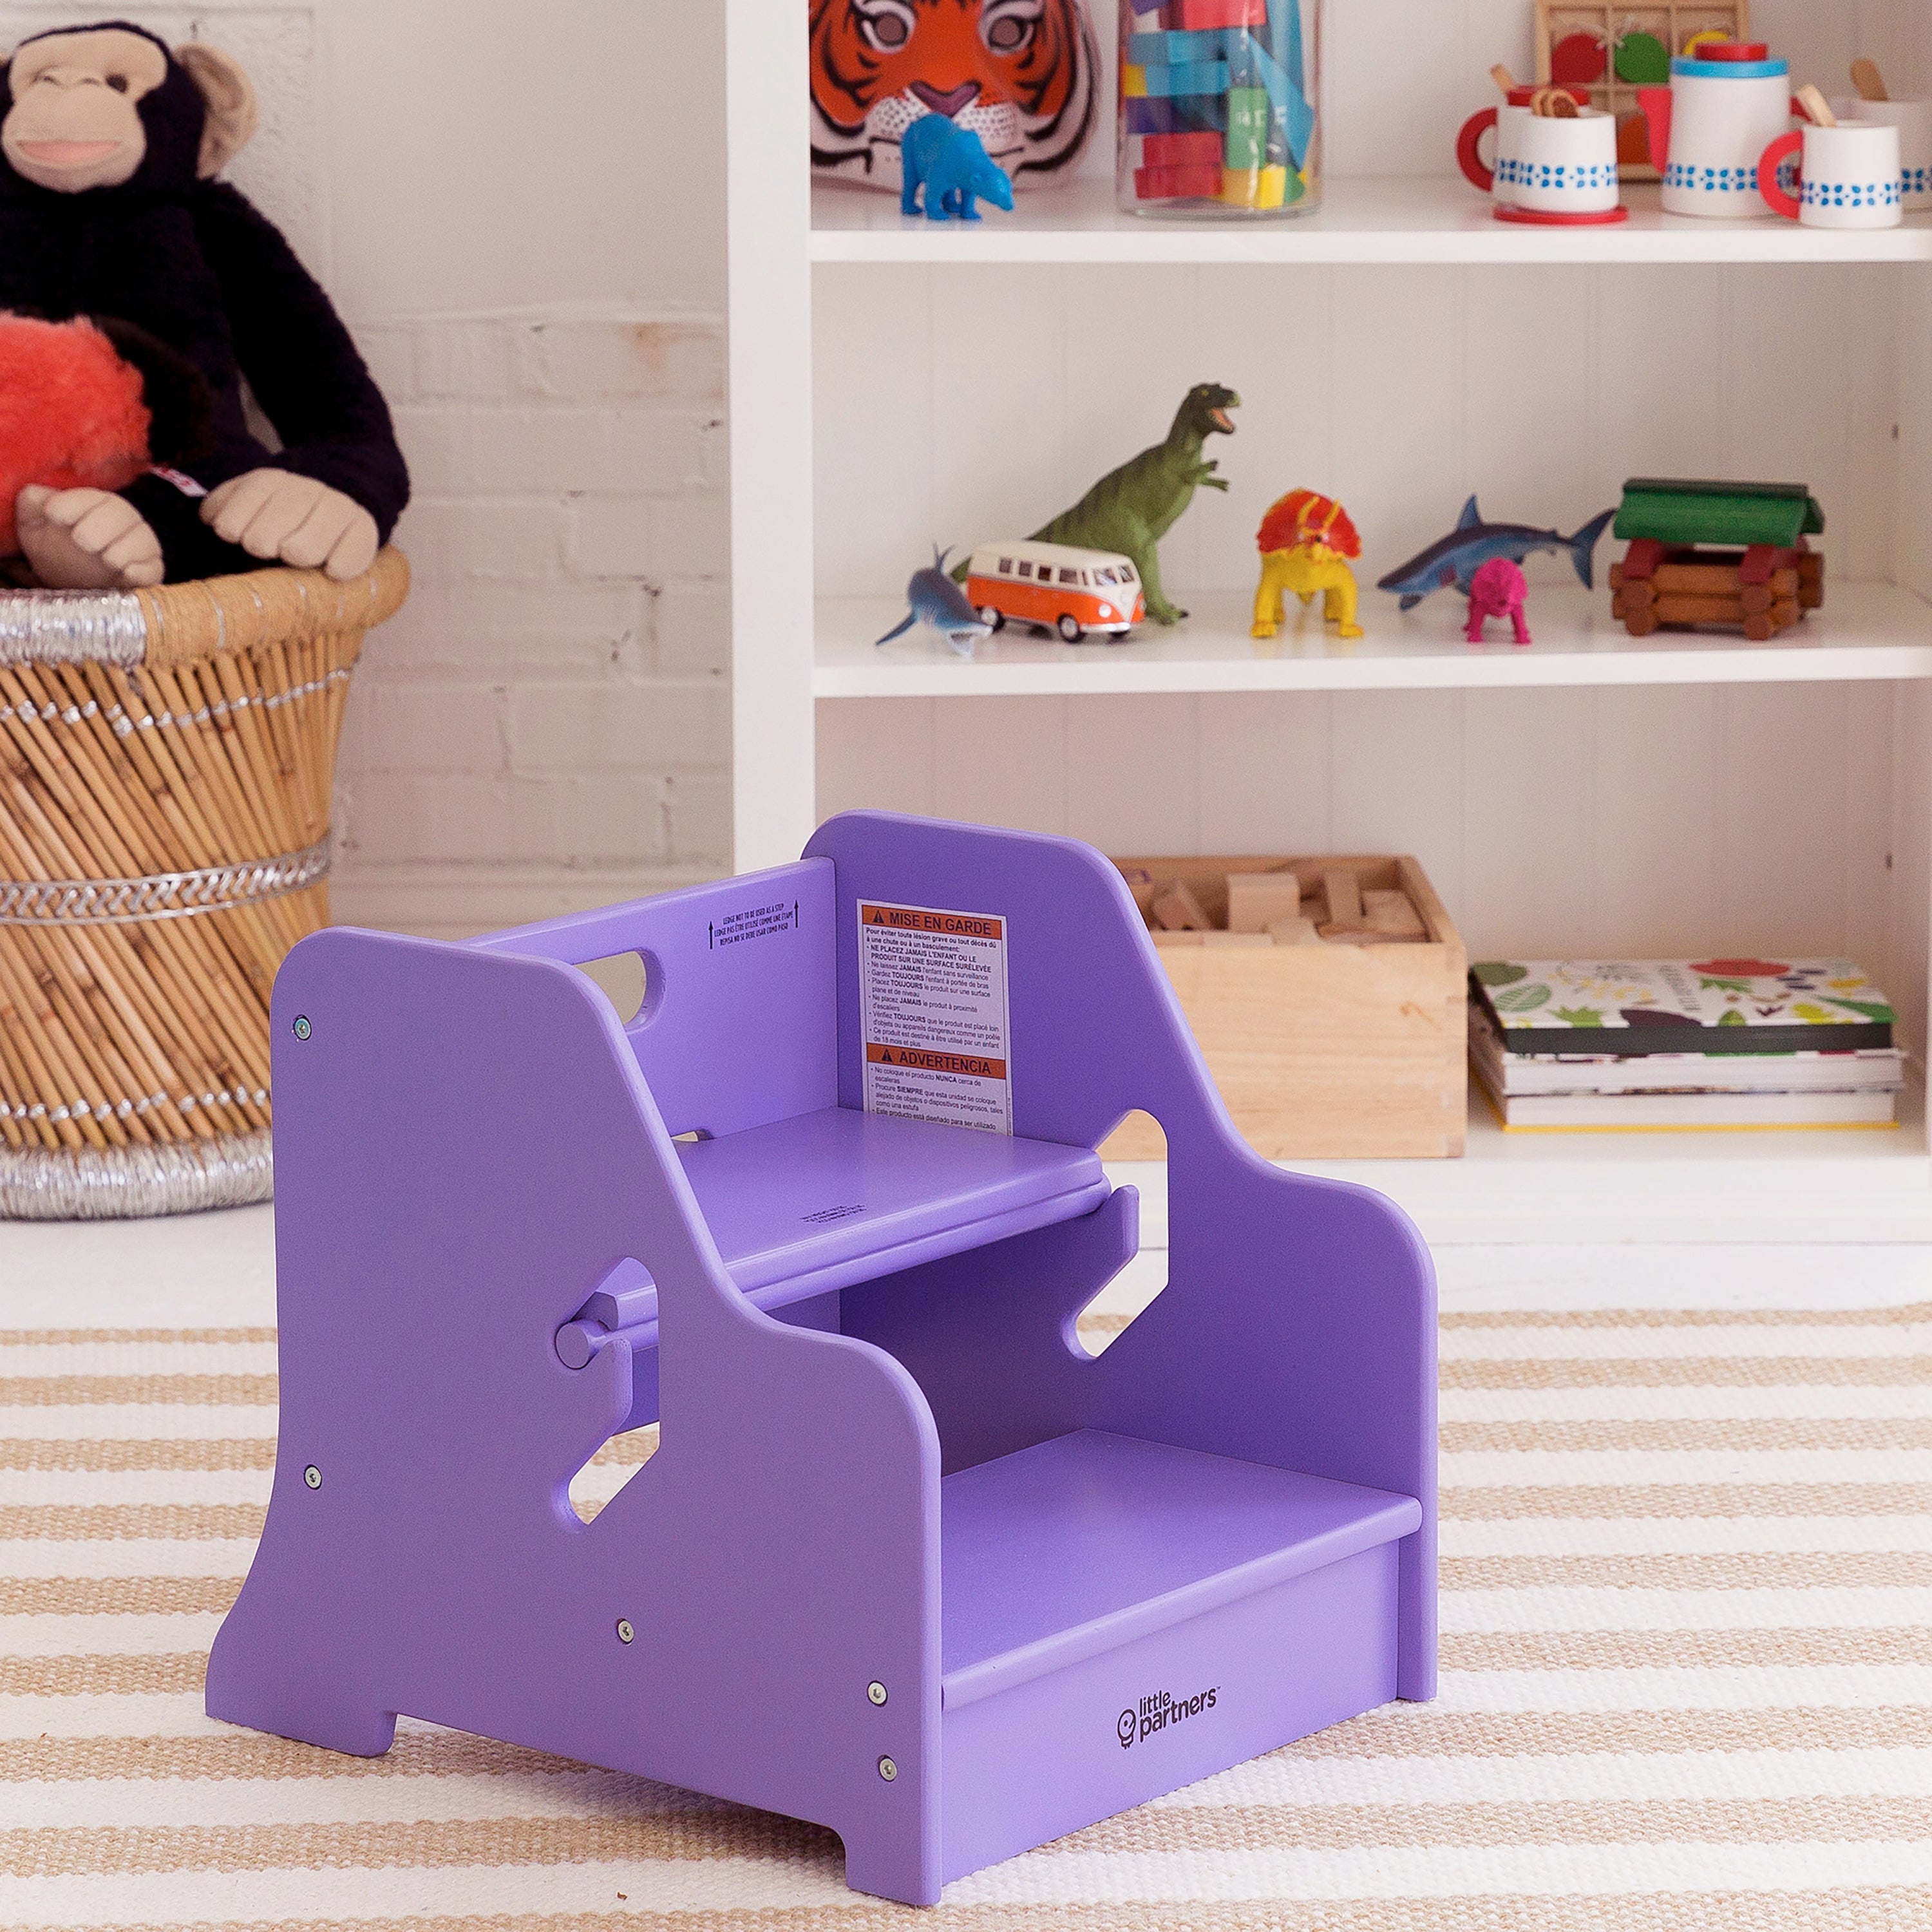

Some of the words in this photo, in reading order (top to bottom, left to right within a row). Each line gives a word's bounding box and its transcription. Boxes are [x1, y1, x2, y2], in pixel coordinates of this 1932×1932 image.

[723, 916, 735, 925] LEDGE
[744, 911, 749, 919] TO
[889, 912, 920, 927] MISE
[924, 916, 941, 929] EN
[945, 918, 991, 934] GARDE
[880, 945, 903, 954] PLACEZ
[905, 948, 927, 956] JAMAIS
[871, 952, 896, 961] PRODUIT
[926, 959, 954, 968] SURFACE
[892, 972, 923, 981] TOUJOURS
[951, 979, 967, 987] portée
[899, 964, 921, 972] JAMAIS
[957, 972, 988, 981] surveillance
[891, 980, 922, 989] TOUJOURS
[930, 985, 948, 994] produit
[881, 996, 898, 1004] placez
[929, 1001, 947, 1010] produit
[953, 1004, 977, 1014] proximité
[894, 1013, 925, 1023] TOUJOURS
[945, 1020, 963, 1028] produit
[973, 1023, 987, 1032] placé
[902, 1023, 925, 1032] appareils
[927, 1025, 954, 1036] dangereux
[882, 1028, 900, 1037] produit
[911, 1032, 929, 1040] destiné
[899, 1050, 990, 1075] ADVERTENCIA
[875, 1075, 900, 1084] escaleras
[884, 1068, 904, 1077] coloque
[911, 1071, 934, 1081] producto
[935, 1074, 956, 1083] NUNCA
[875, 1083, 895, 1092] Procure
[897, 1086, 923, 1095] SIEMPRE
[975, 1096, 996, 1106] coloque
[875, 1091, 894, 1101] alejado
[904, 1095, 922, 1104] objetos
[929, 1098, 958, 1109] dispositivos
[889, 1109, 911, 1119] producto
[925, 1113, 949, 1122] diseñado
[974, 1121, 995, 1130] utilizado
[1139, 1690, 1171, 1717] little
[1140, 1688, 1217, 1743] partners
